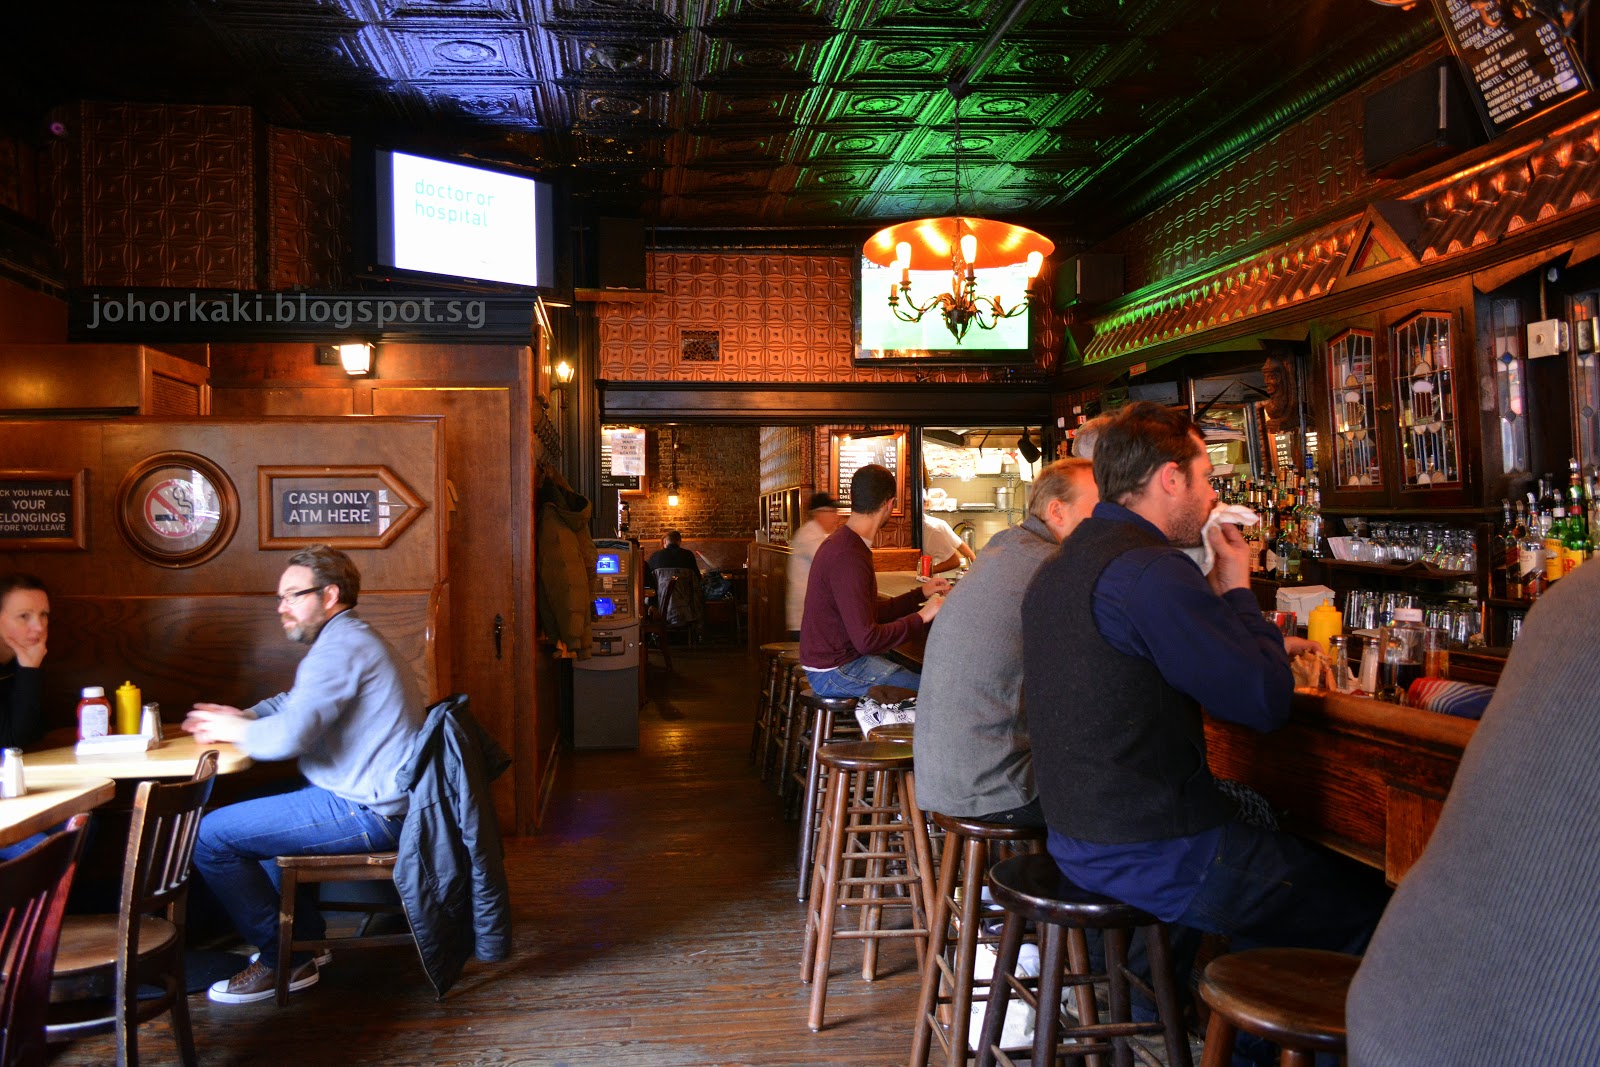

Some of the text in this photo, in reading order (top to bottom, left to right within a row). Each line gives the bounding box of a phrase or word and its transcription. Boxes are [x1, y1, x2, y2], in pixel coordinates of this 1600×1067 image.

[1458, 22, 1481, 41] STELLA
[1474, 26, 1508, 49] SEASONAL
[1485, 33, 1514, 55] BOTTLES
[1480, 74, 1506, 91] AMSTEL
[1507, 60, 1529, 76] LIGHT
[1539, 87, 1557, 101] CIDE
[415, 178, 495, 206] doctor or
[415, 199, 488, 228] hospital
[12, 500, 46, 510] YOUR
[289, 492, 370, 505] CASH ONLY
[289, 509, 371, 523] ATM HERE
